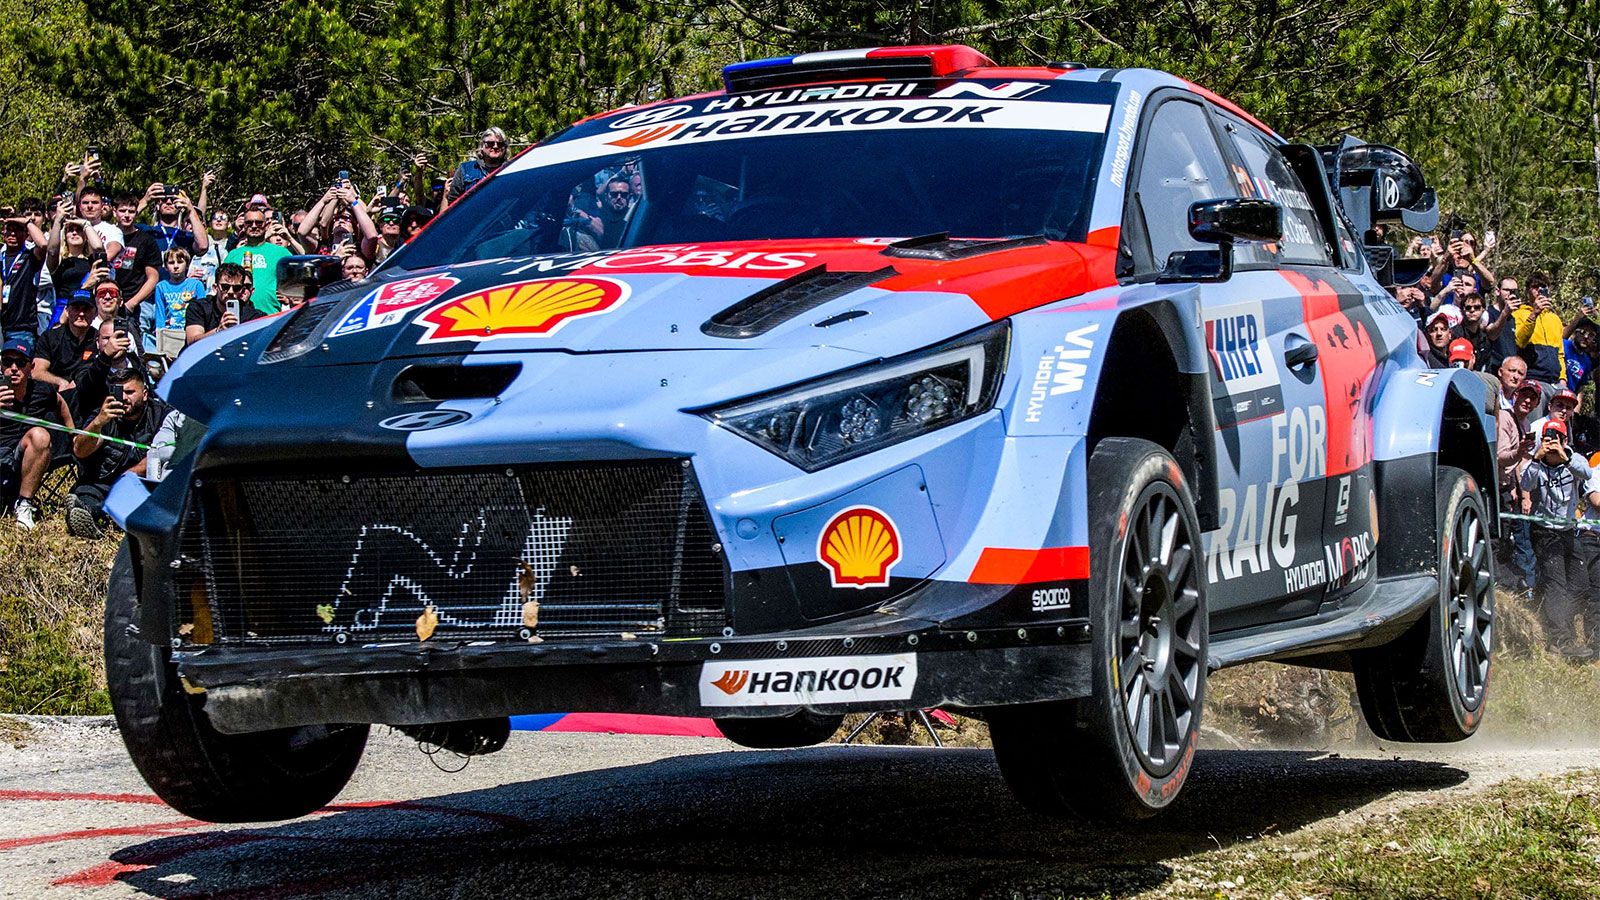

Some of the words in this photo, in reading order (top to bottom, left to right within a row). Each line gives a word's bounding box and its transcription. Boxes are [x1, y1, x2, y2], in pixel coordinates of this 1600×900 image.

[702, 82, 918, 112] HYUNDAI
[1110, 89, 1142, 188] motorsport.hyundai.com
[501, 251, 817, 276] MOBIS
[1025, 355, 1056, 423] HYUNDAI
[1271, 405, 1327, 486] FOR
[1204, 478, 1300, 584] RAIG
[1284, 559, 1327, 594] HYUNDAI
[1325, 531, 1371, 593] MOBIS
[1031, 587, 1071, 612] sparco
